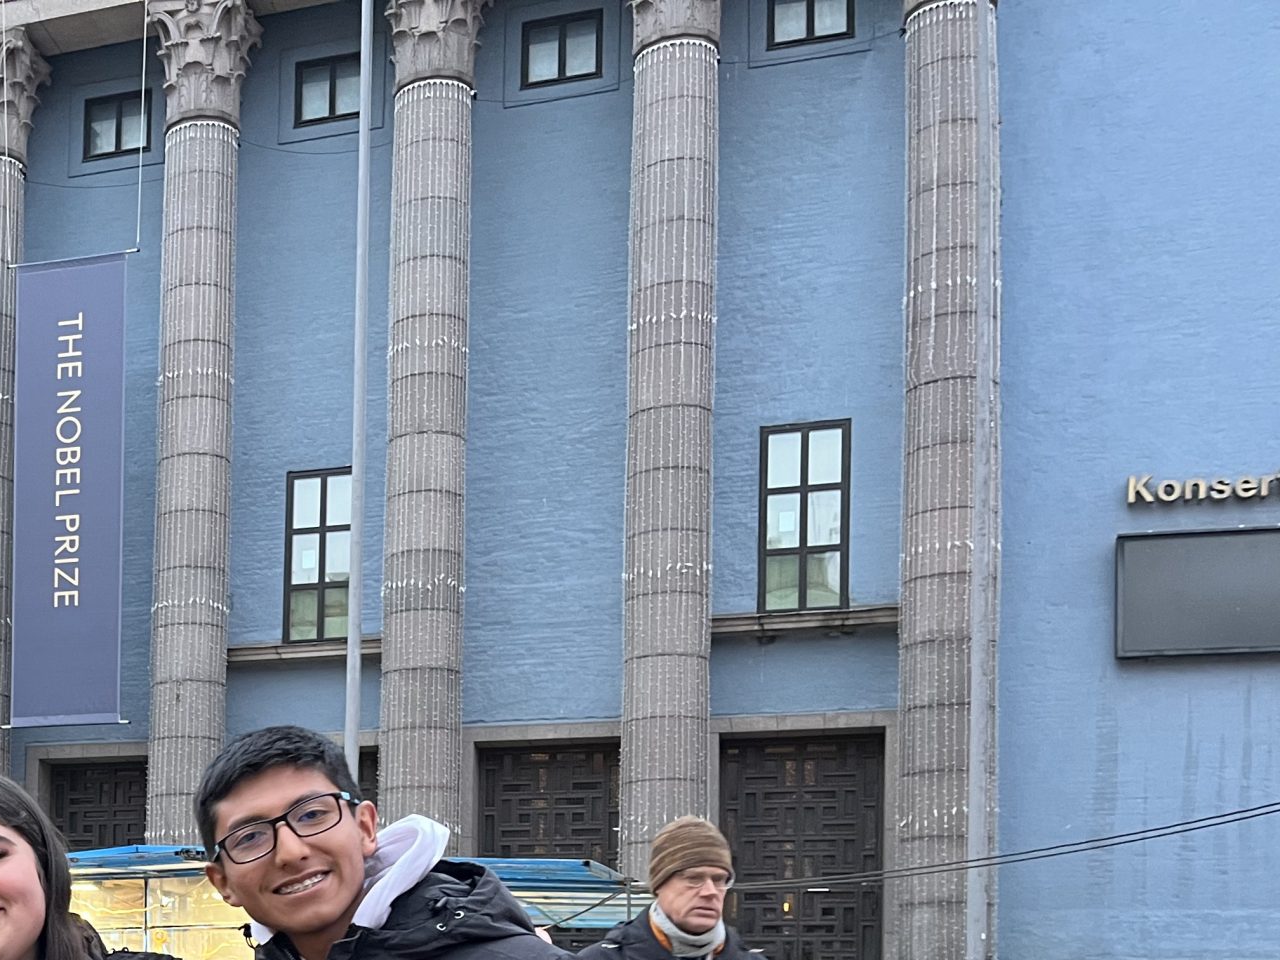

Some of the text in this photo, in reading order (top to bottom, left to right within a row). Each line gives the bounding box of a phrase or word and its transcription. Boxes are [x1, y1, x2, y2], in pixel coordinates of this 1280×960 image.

[53, 311, 84, 608] THE NOBEL PRIZE
[1127, 473, 1280, 504] Konser
